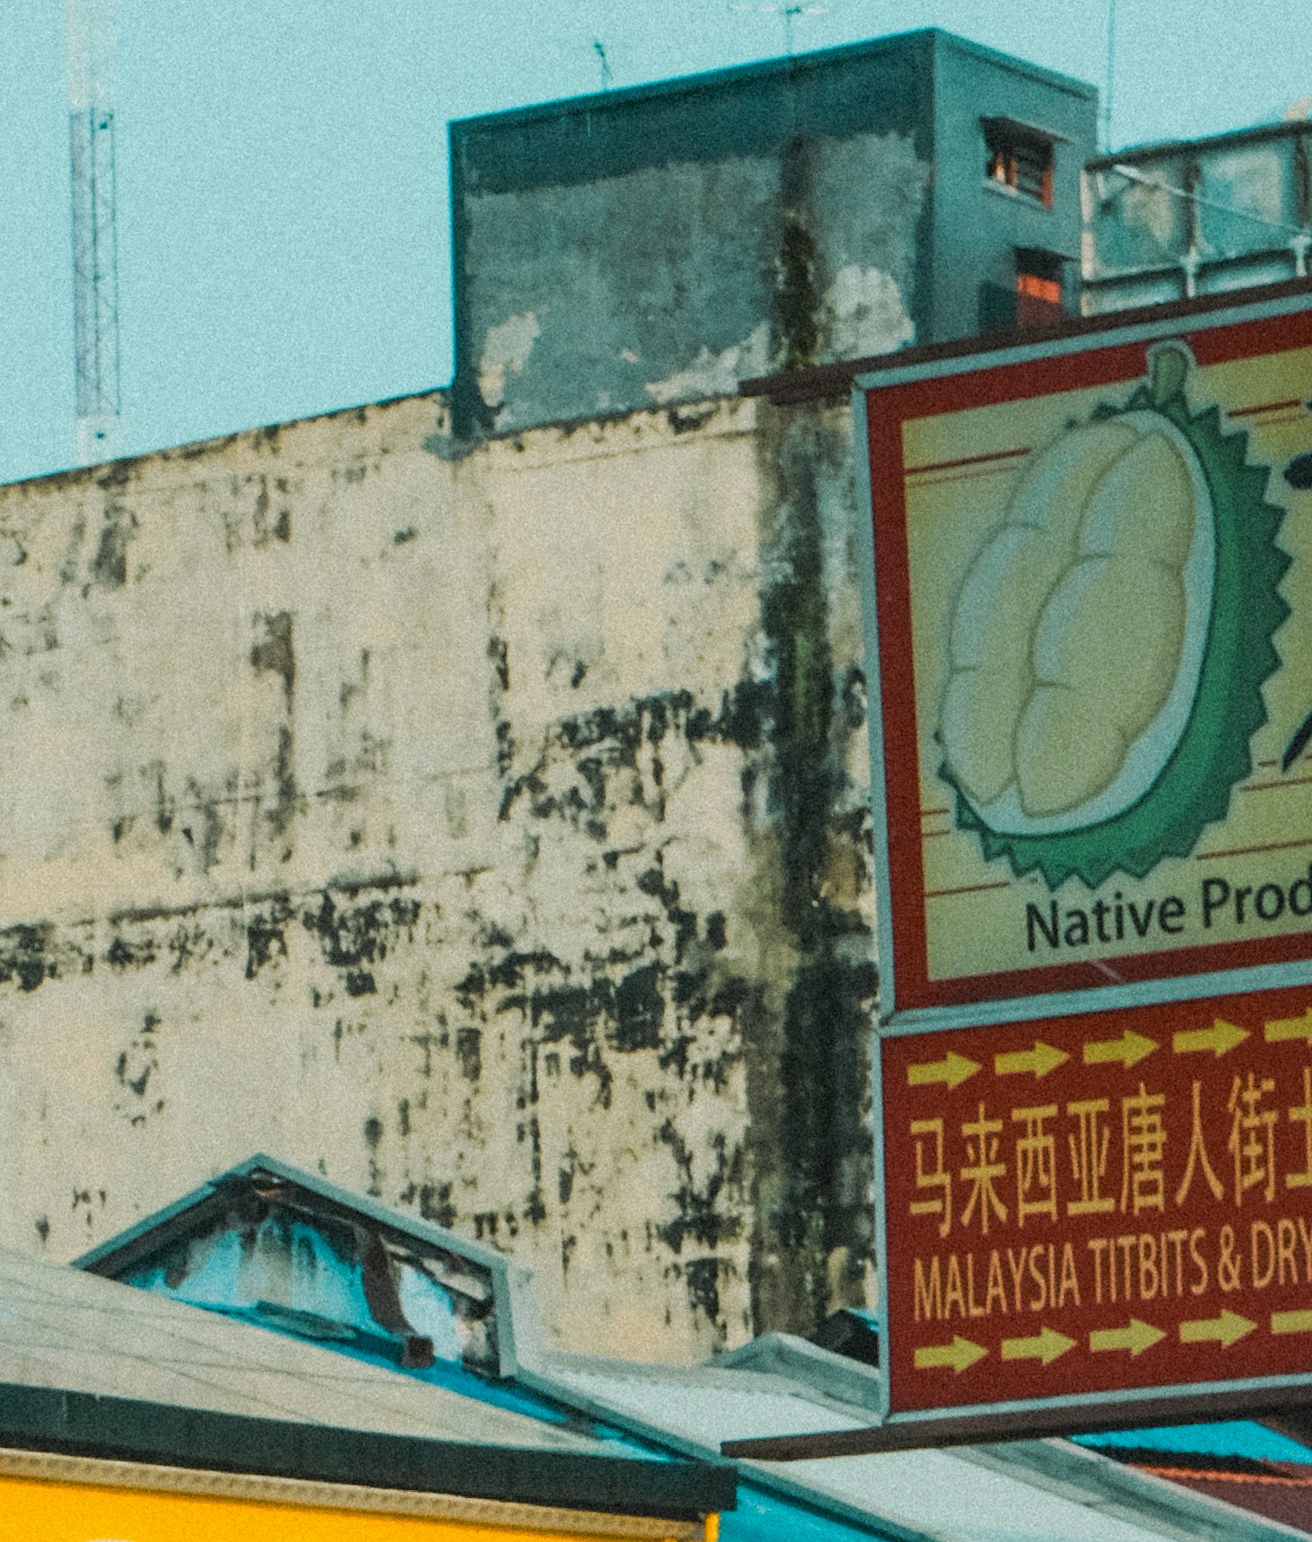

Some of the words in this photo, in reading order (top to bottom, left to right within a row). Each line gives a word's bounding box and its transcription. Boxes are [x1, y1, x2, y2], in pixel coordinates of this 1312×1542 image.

[1026, 890, 1186, 953] Native
[914, 1242, 1081, 1322] MALAYSIA
[1087, 1228, 1209, 1305] TITBITS
[1217, 1223, 1243, 1293] &
